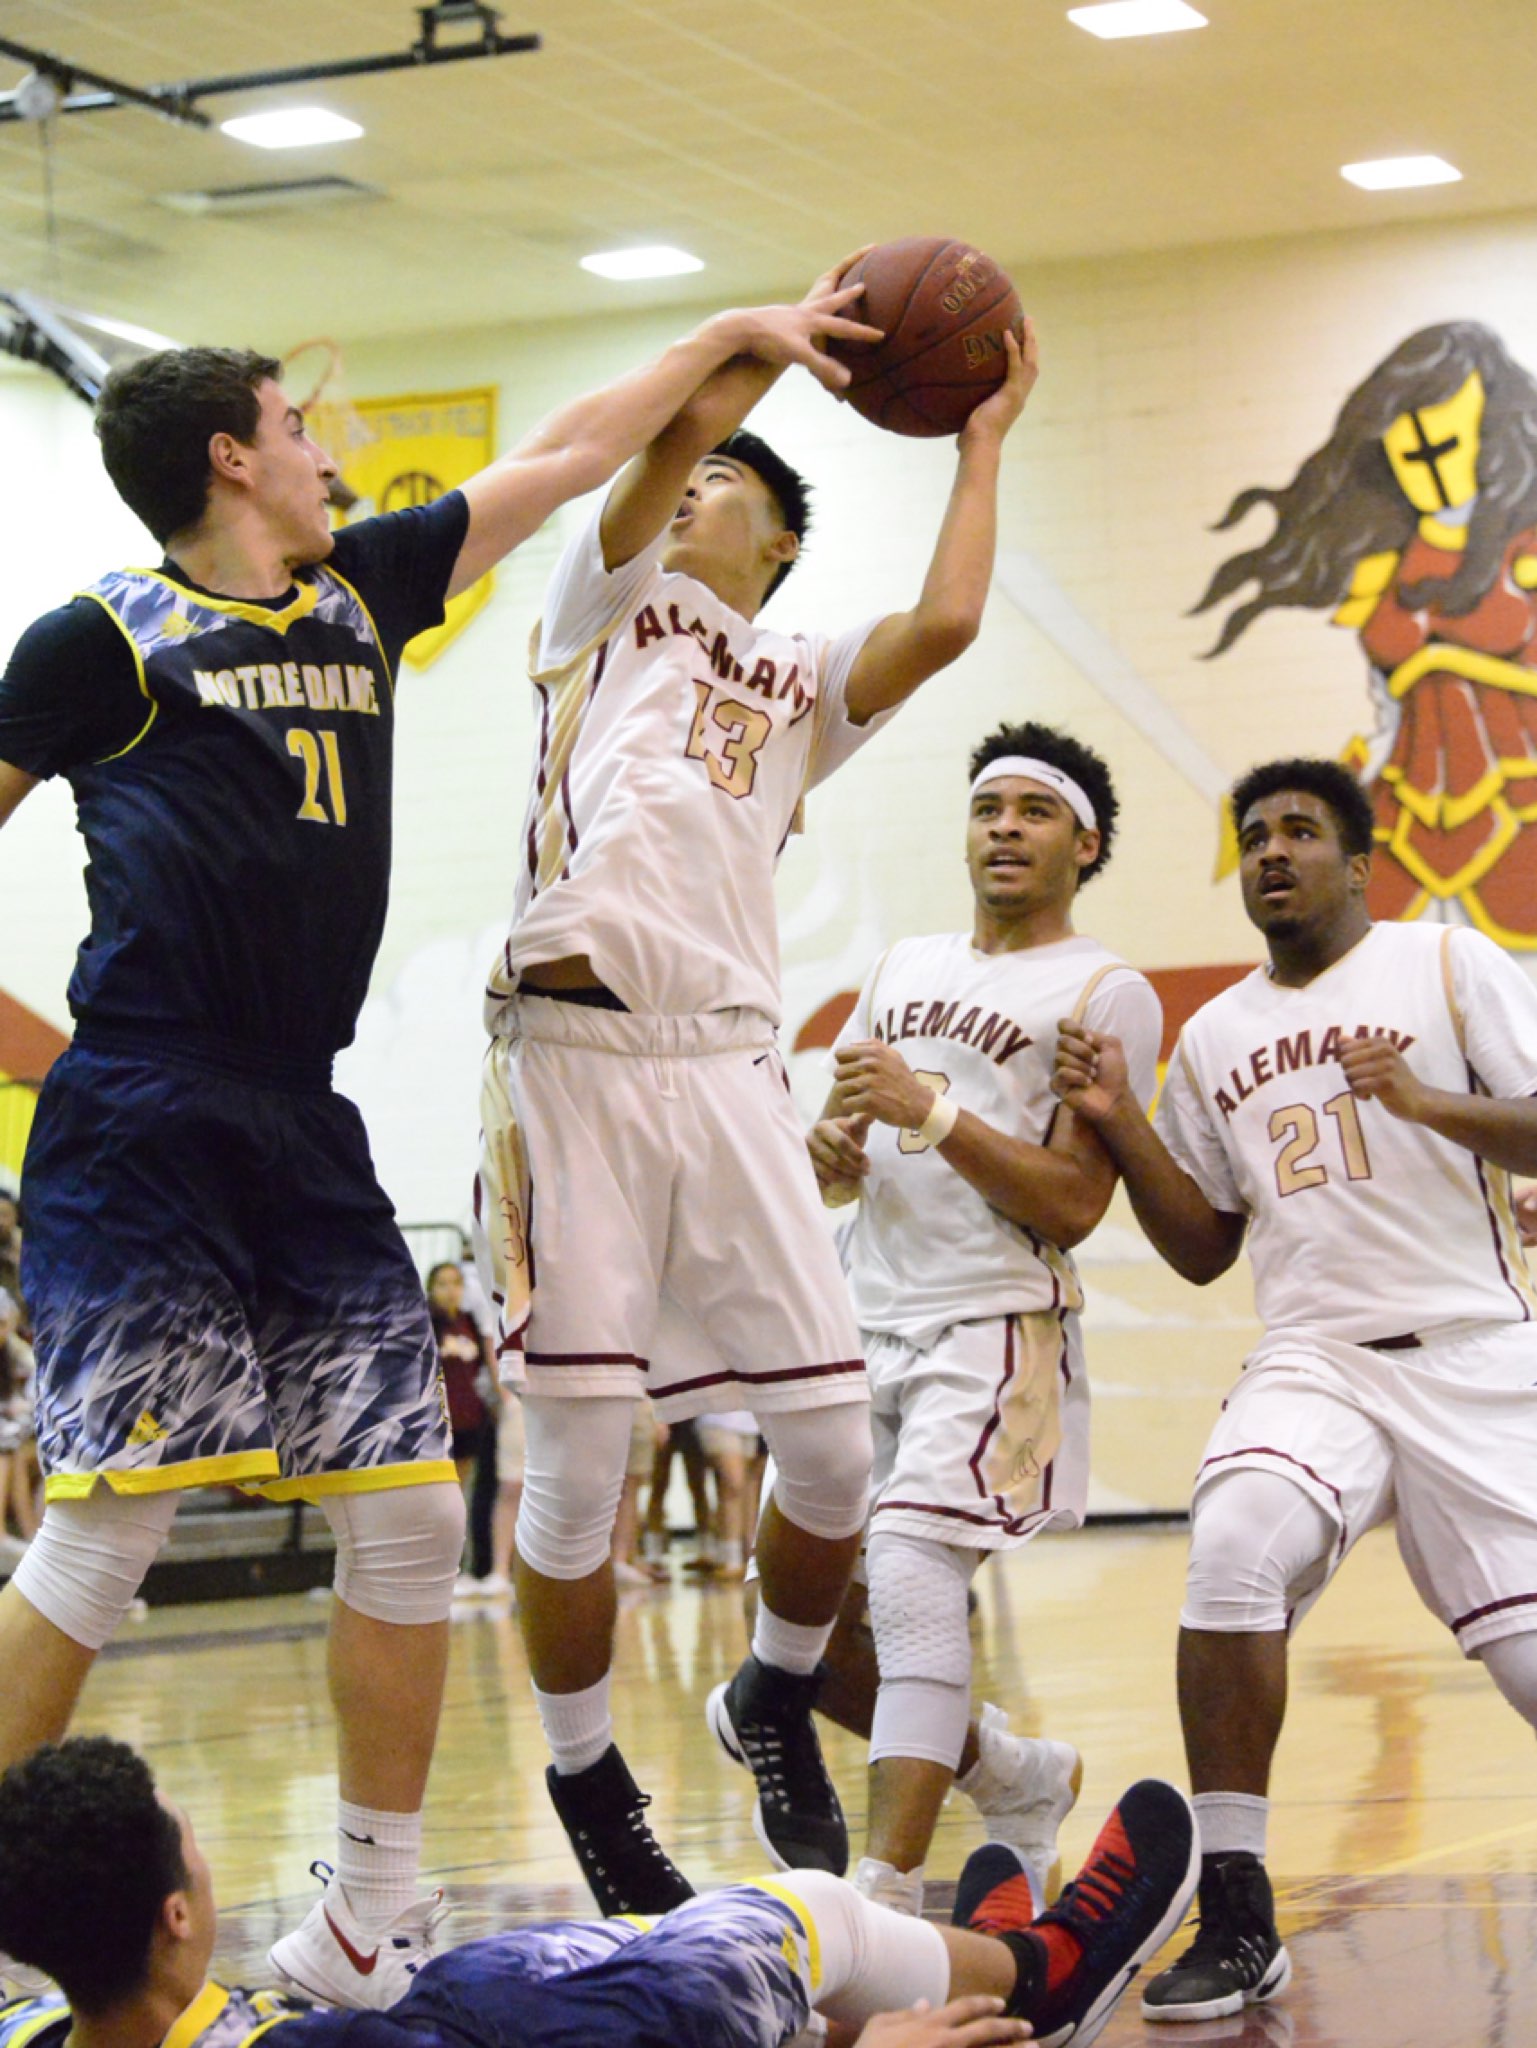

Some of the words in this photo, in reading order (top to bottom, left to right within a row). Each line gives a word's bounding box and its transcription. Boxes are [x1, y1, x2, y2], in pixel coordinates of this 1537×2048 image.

[192, 661, 306, 711] NOTRE
[684, 677, 773, 800] 13
[285, 726, 347, 828] 21
[1266, 1090, 1372, 1198] 21
